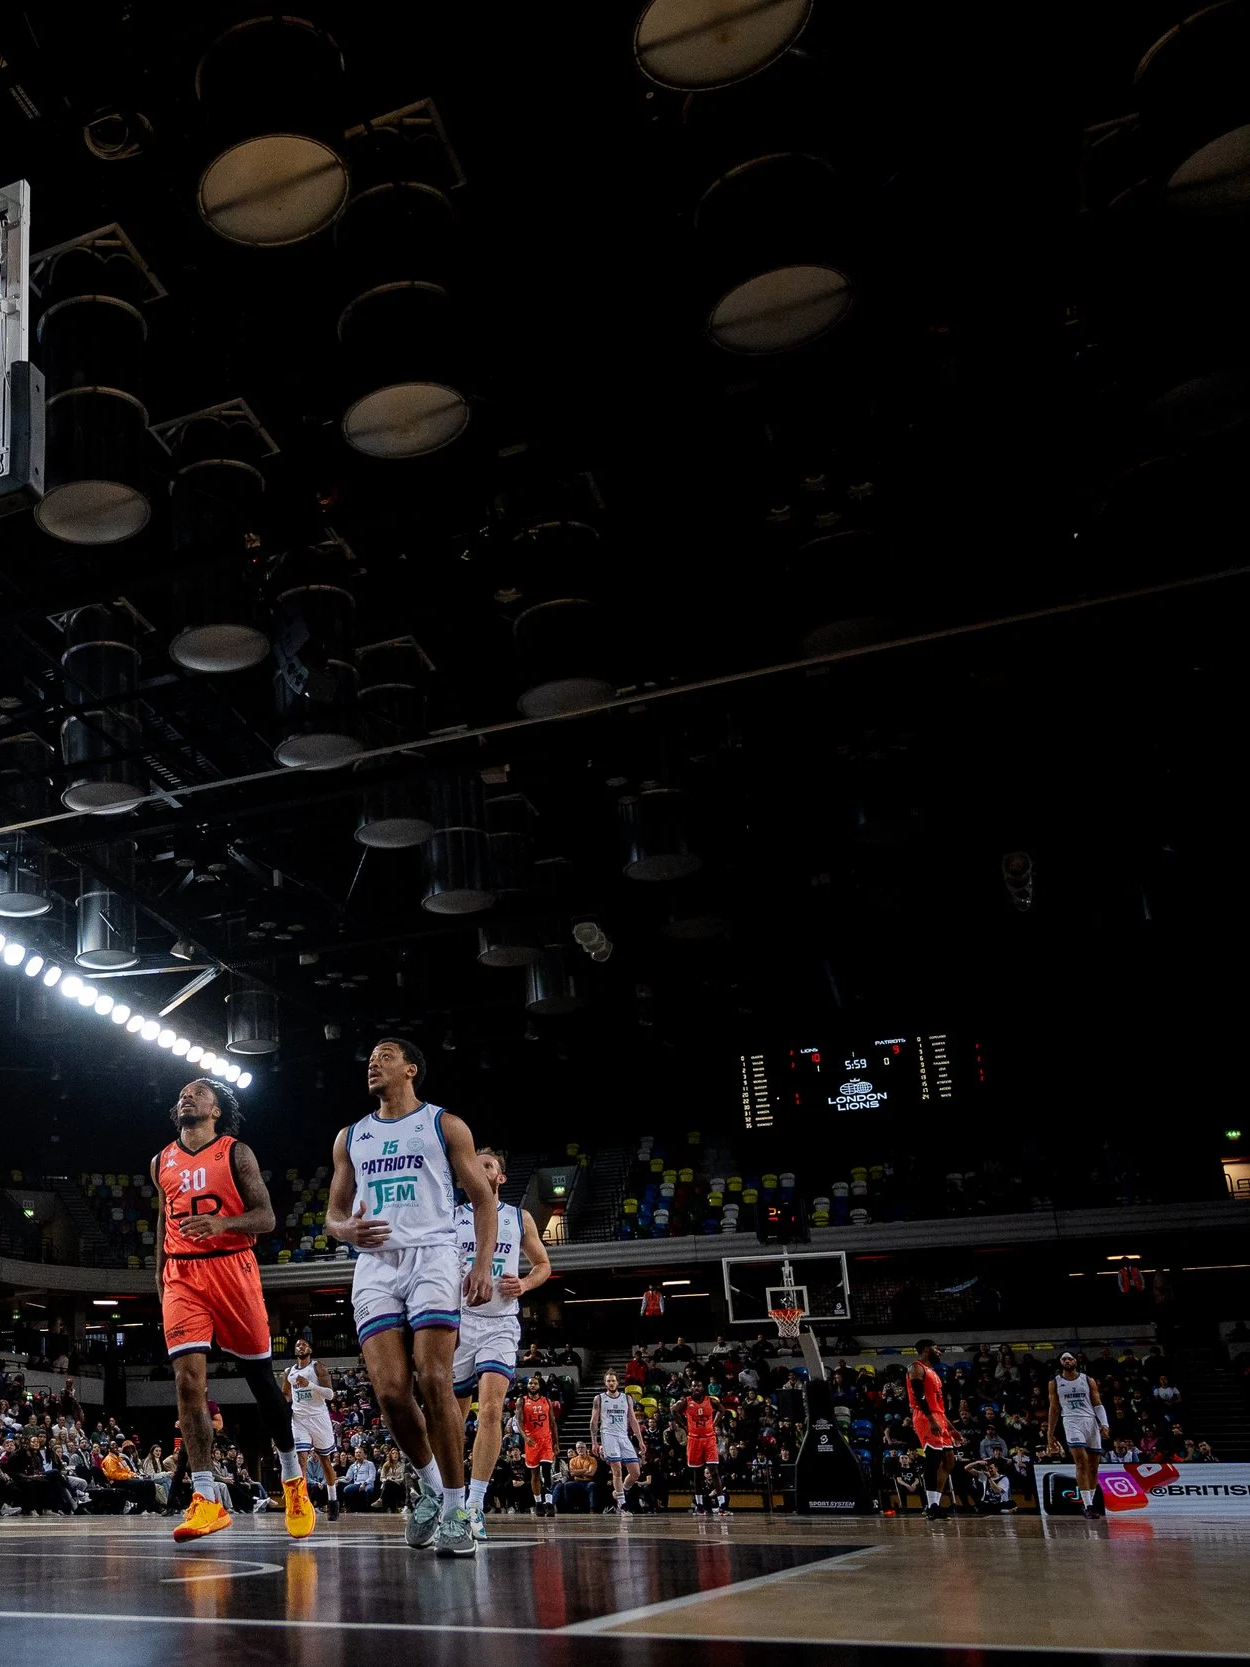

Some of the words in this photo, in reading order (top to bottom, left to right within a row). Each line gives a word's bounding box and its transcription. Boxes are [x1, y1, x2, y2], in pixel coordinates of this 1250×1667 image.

[875, 1038, 906, 1046] PATRIOTS
[892, 1045, 900, 1055] 9
[811, 1053, 821, 1063] 10
[883, 1057, 890, 1065] 0
[845, 1059, 867, 1070] 5:59
[828, 1092, 888, 1105] LONDON
[837, 1100, 880, 1111] LIONS
[382, 1139, 399, 1155] 15
[361, 1155, 424, 1176] PATRIOTS
[179, 1167, 206, 1192] 30
[532, 1405, 543, 1413] 22
[1150, 1485, 1250, 1497] @BRITIS
